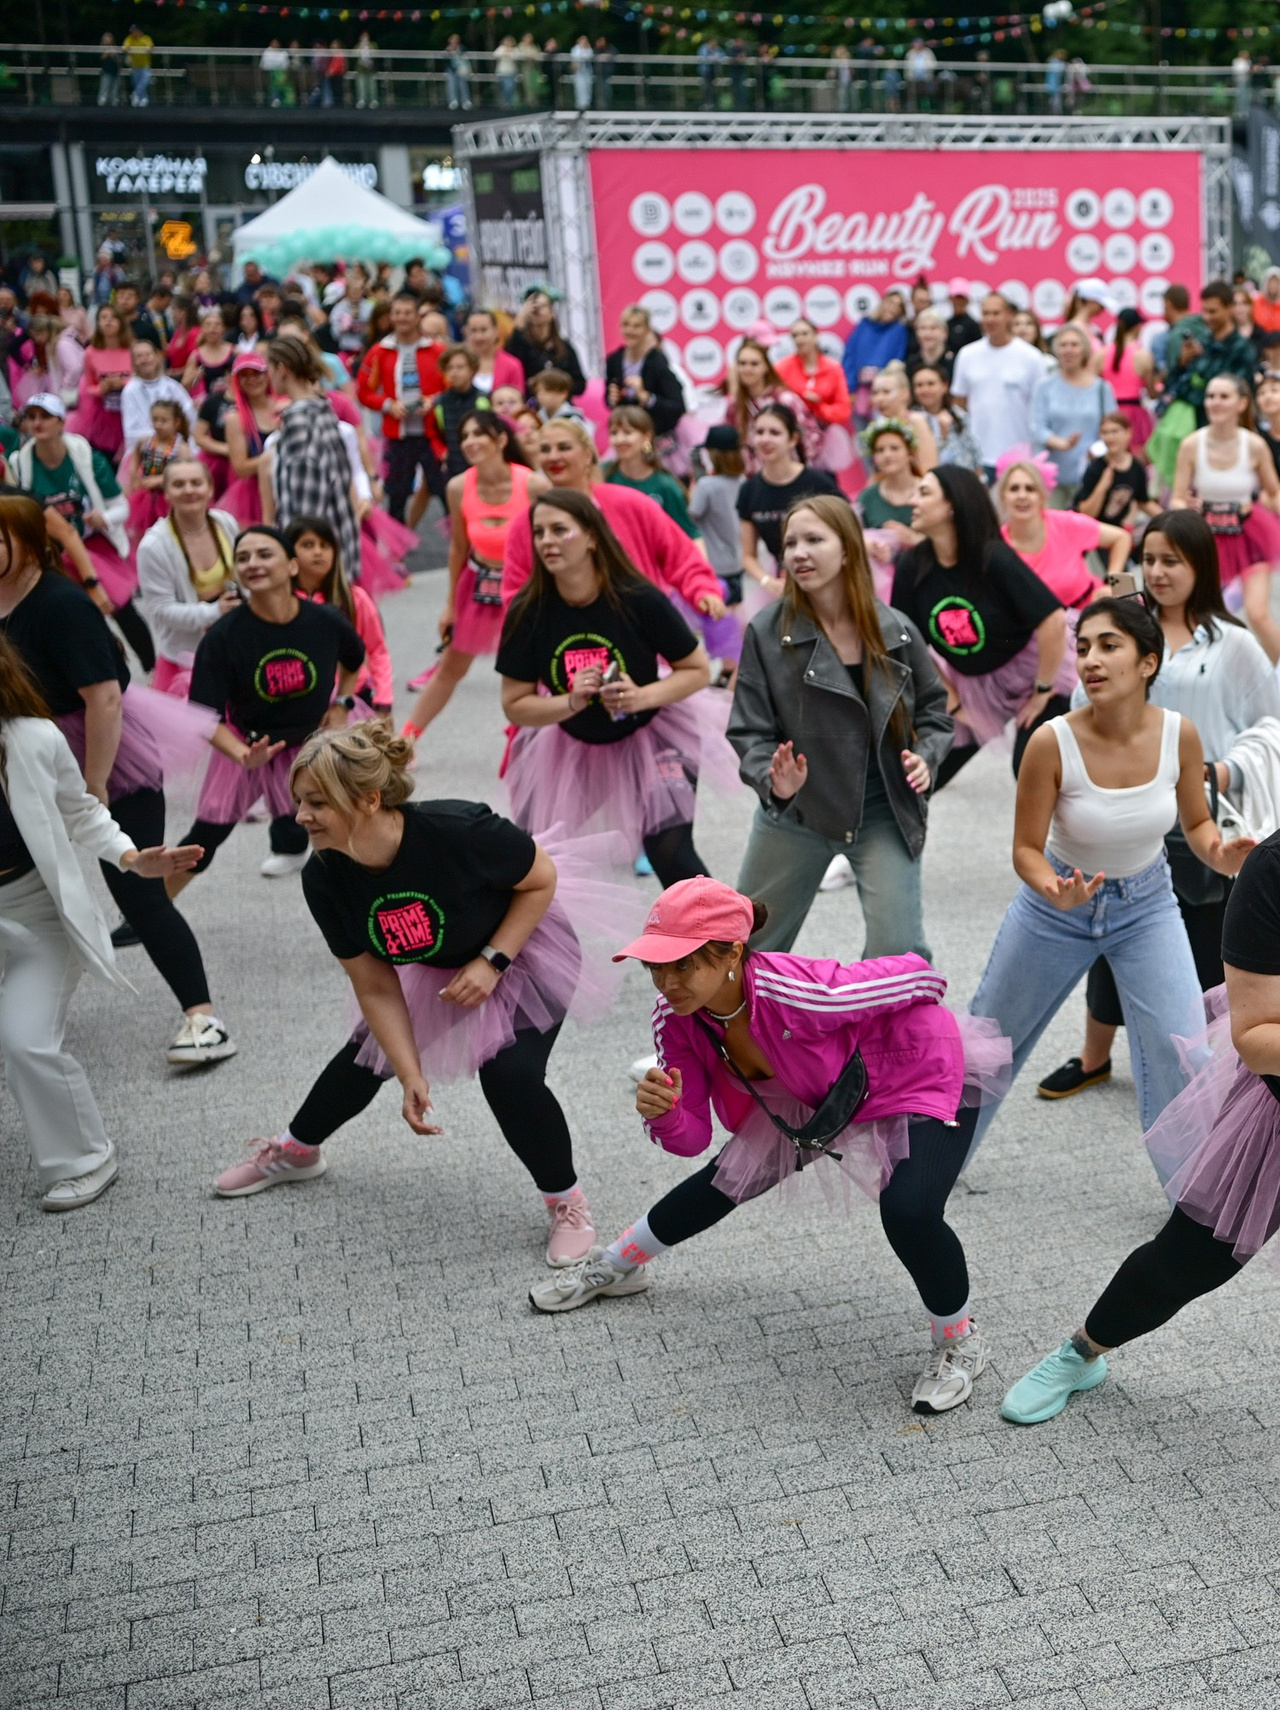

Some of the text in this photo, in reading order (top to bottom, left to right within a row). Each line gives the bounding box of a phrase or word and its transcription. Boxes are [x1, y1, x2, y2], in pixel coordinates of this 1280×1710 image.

[95, 154, 208, 176] КОФЕЙНАЯ
[106, 173, 203, 193] ГАЛЕРЕЯ
[762, 183, 1063, 278] Beauty Run
[396, 920, 433, 947] TIME
